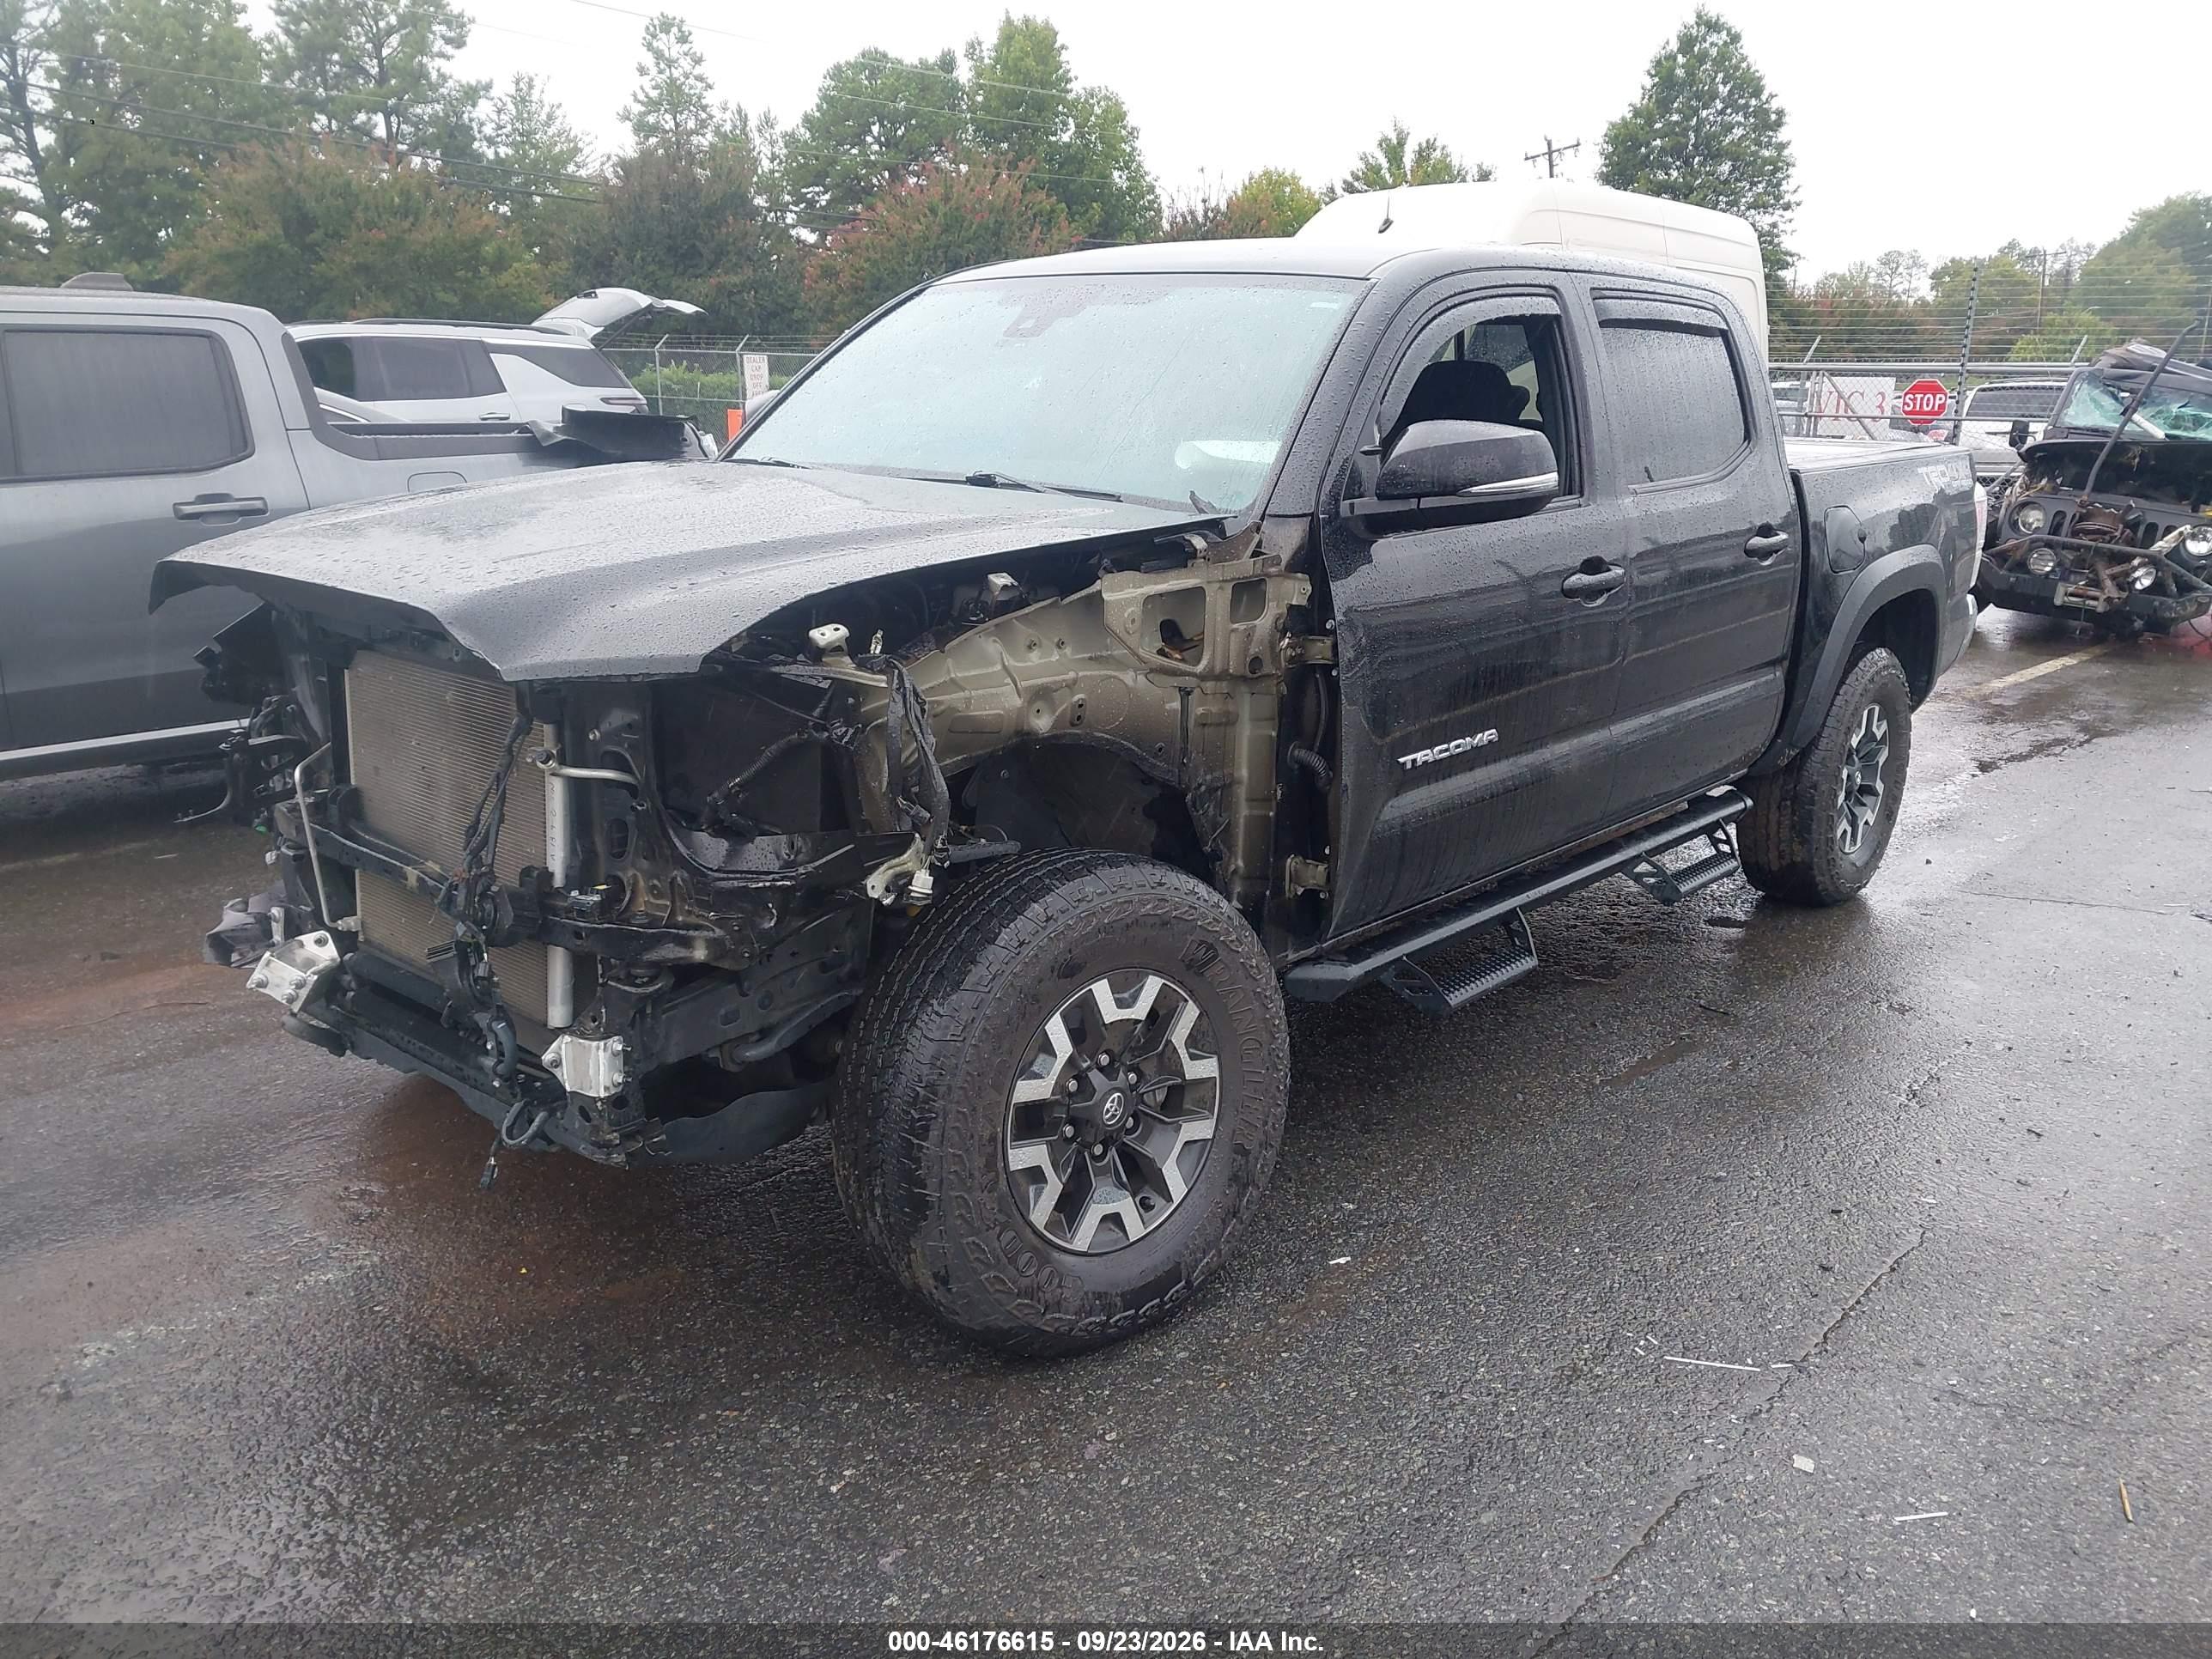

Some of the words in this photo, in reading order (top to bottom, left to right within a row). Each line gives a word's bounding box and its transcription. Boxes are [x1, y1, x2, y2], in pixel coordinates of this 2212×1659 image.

[1871, 391, 1887, 422] 3
[1904, 393, 1946, 411] STOP
[1396, 728, 1499, 770] TACOMA
[1178, 936, 1265, 1150] WRANGLER
